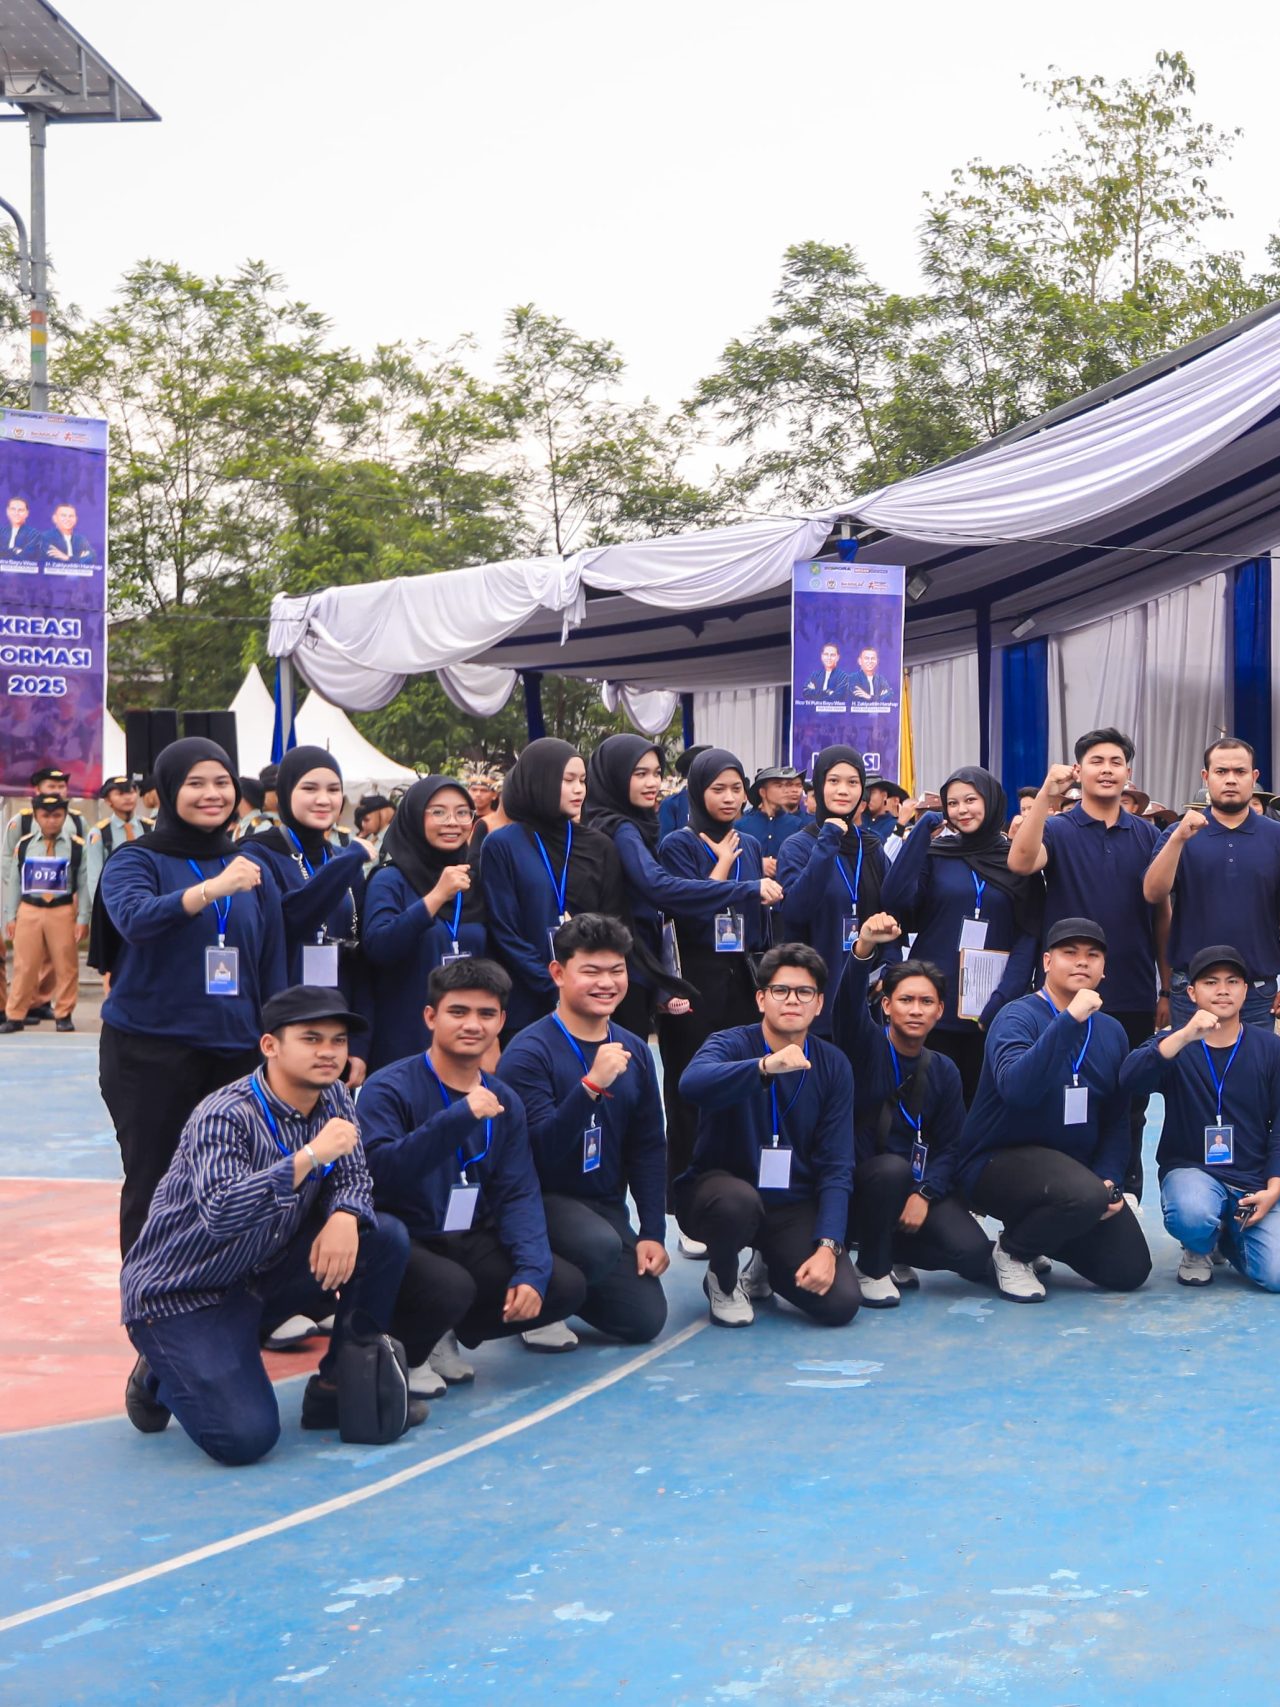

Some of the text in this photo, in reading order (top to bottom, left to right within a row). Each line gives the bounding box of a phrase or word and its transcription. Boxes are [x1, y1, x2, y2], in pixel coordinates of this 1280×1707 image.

[0, 617, 81, 638] KREASI
[0, 645, 91, 668] ORMASI
[9, 675, 67, 697] 2025
[34, 870, 57, 880] 012
